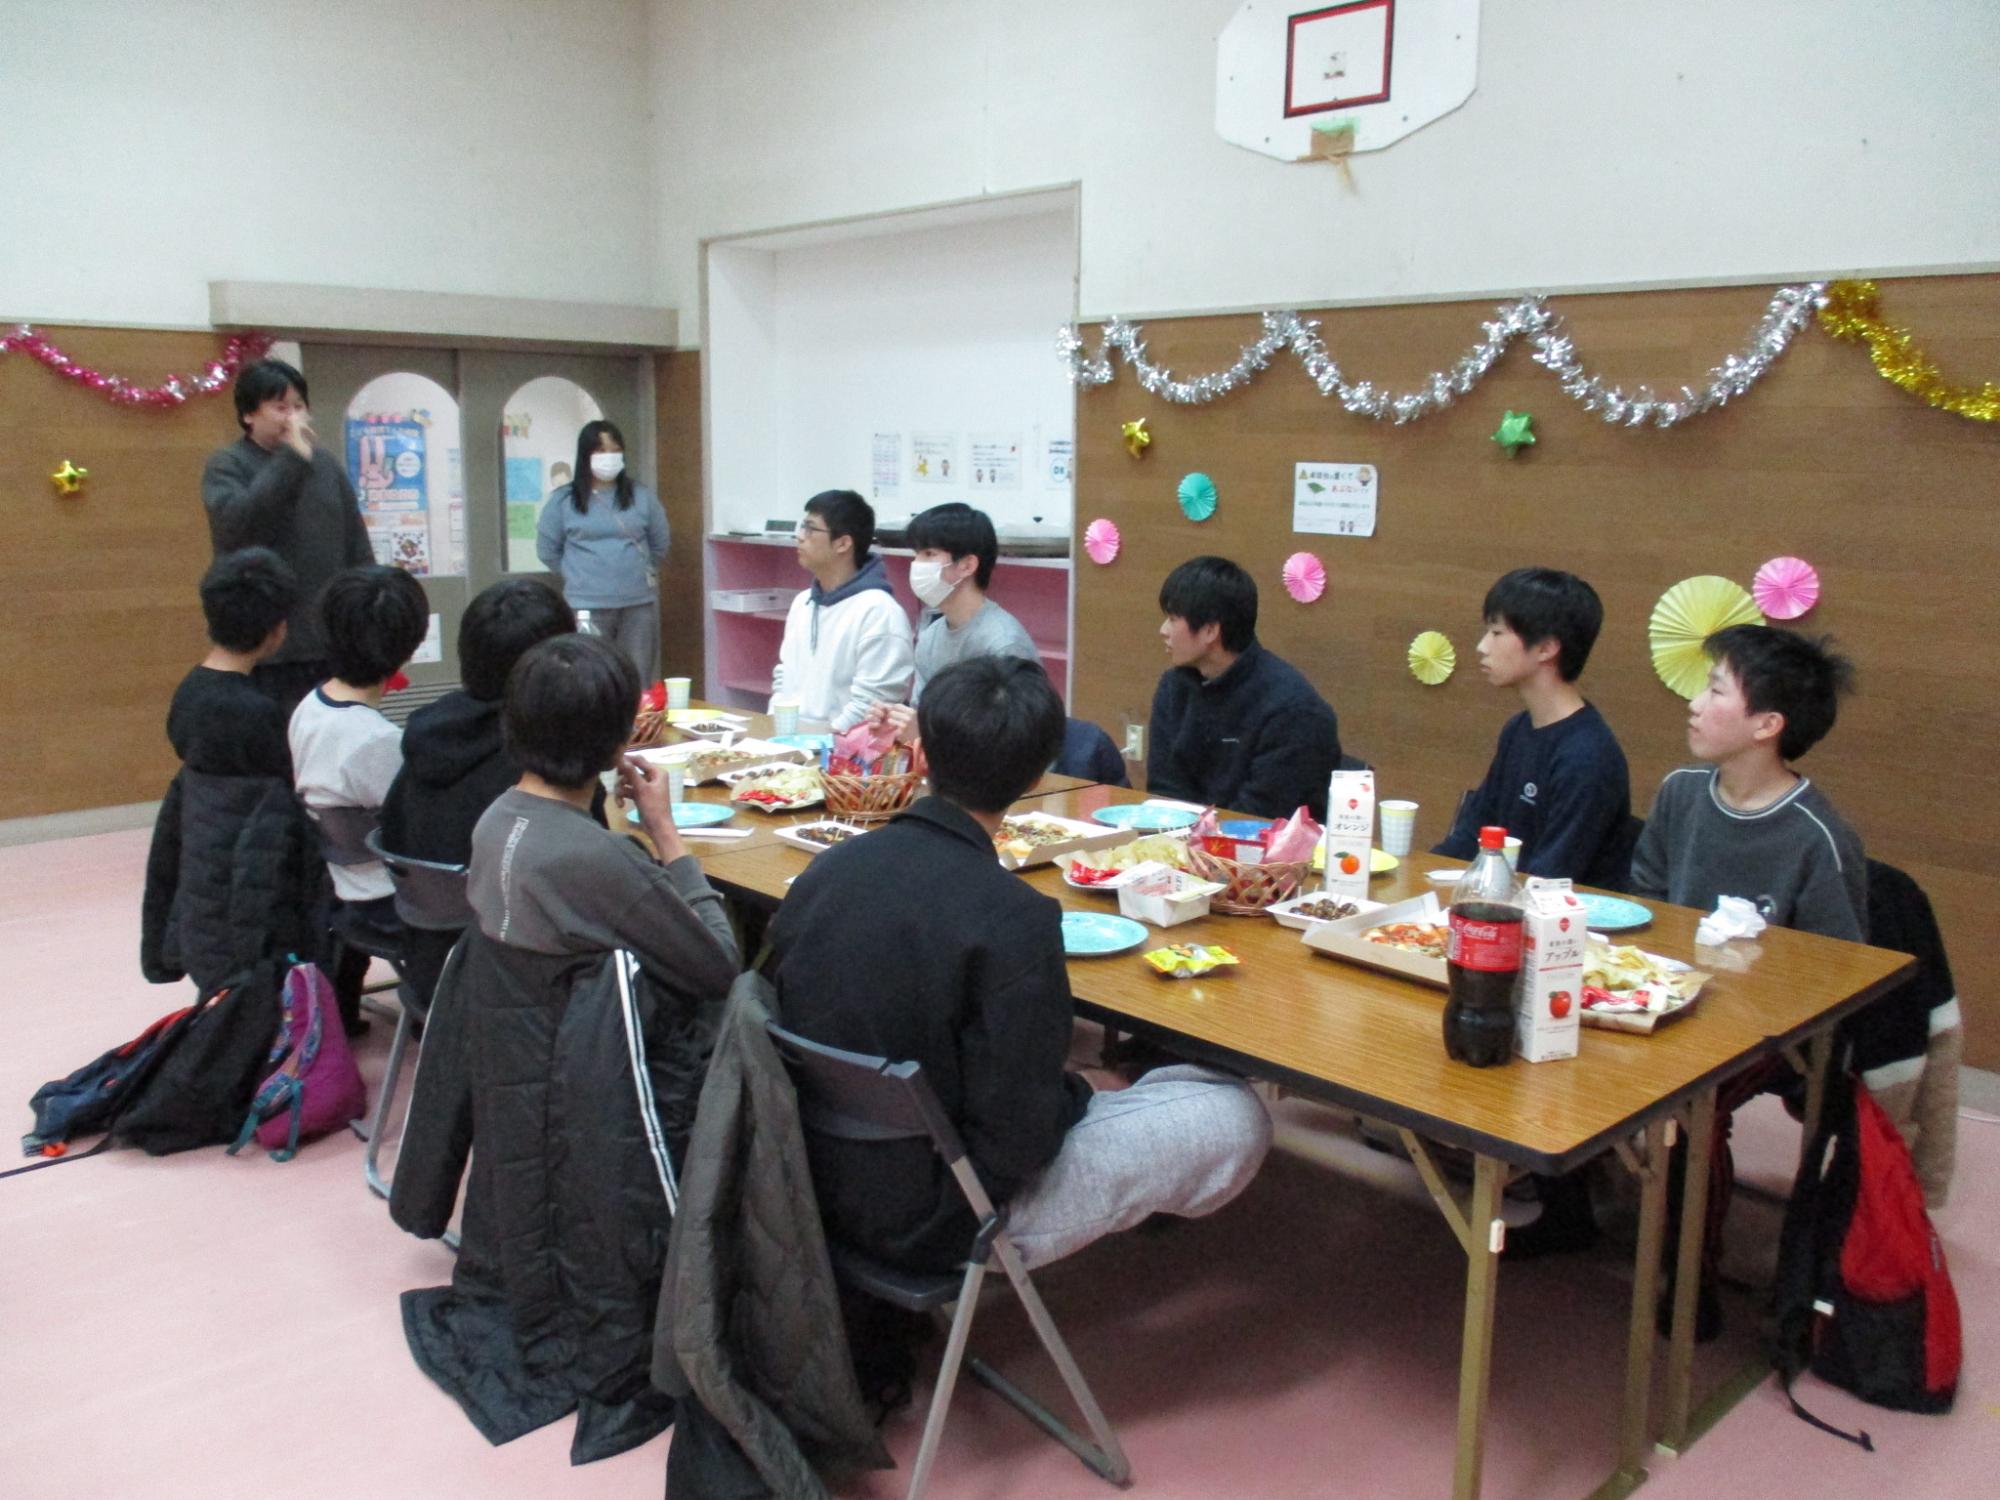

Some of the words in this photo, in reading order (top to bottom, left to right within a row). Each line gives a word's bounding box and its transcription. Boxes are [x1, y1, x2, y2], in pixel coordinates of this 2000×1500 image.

[1334, 822, 1369, 832] オレンジ
[1544, 948, 1579, 961] アップル
